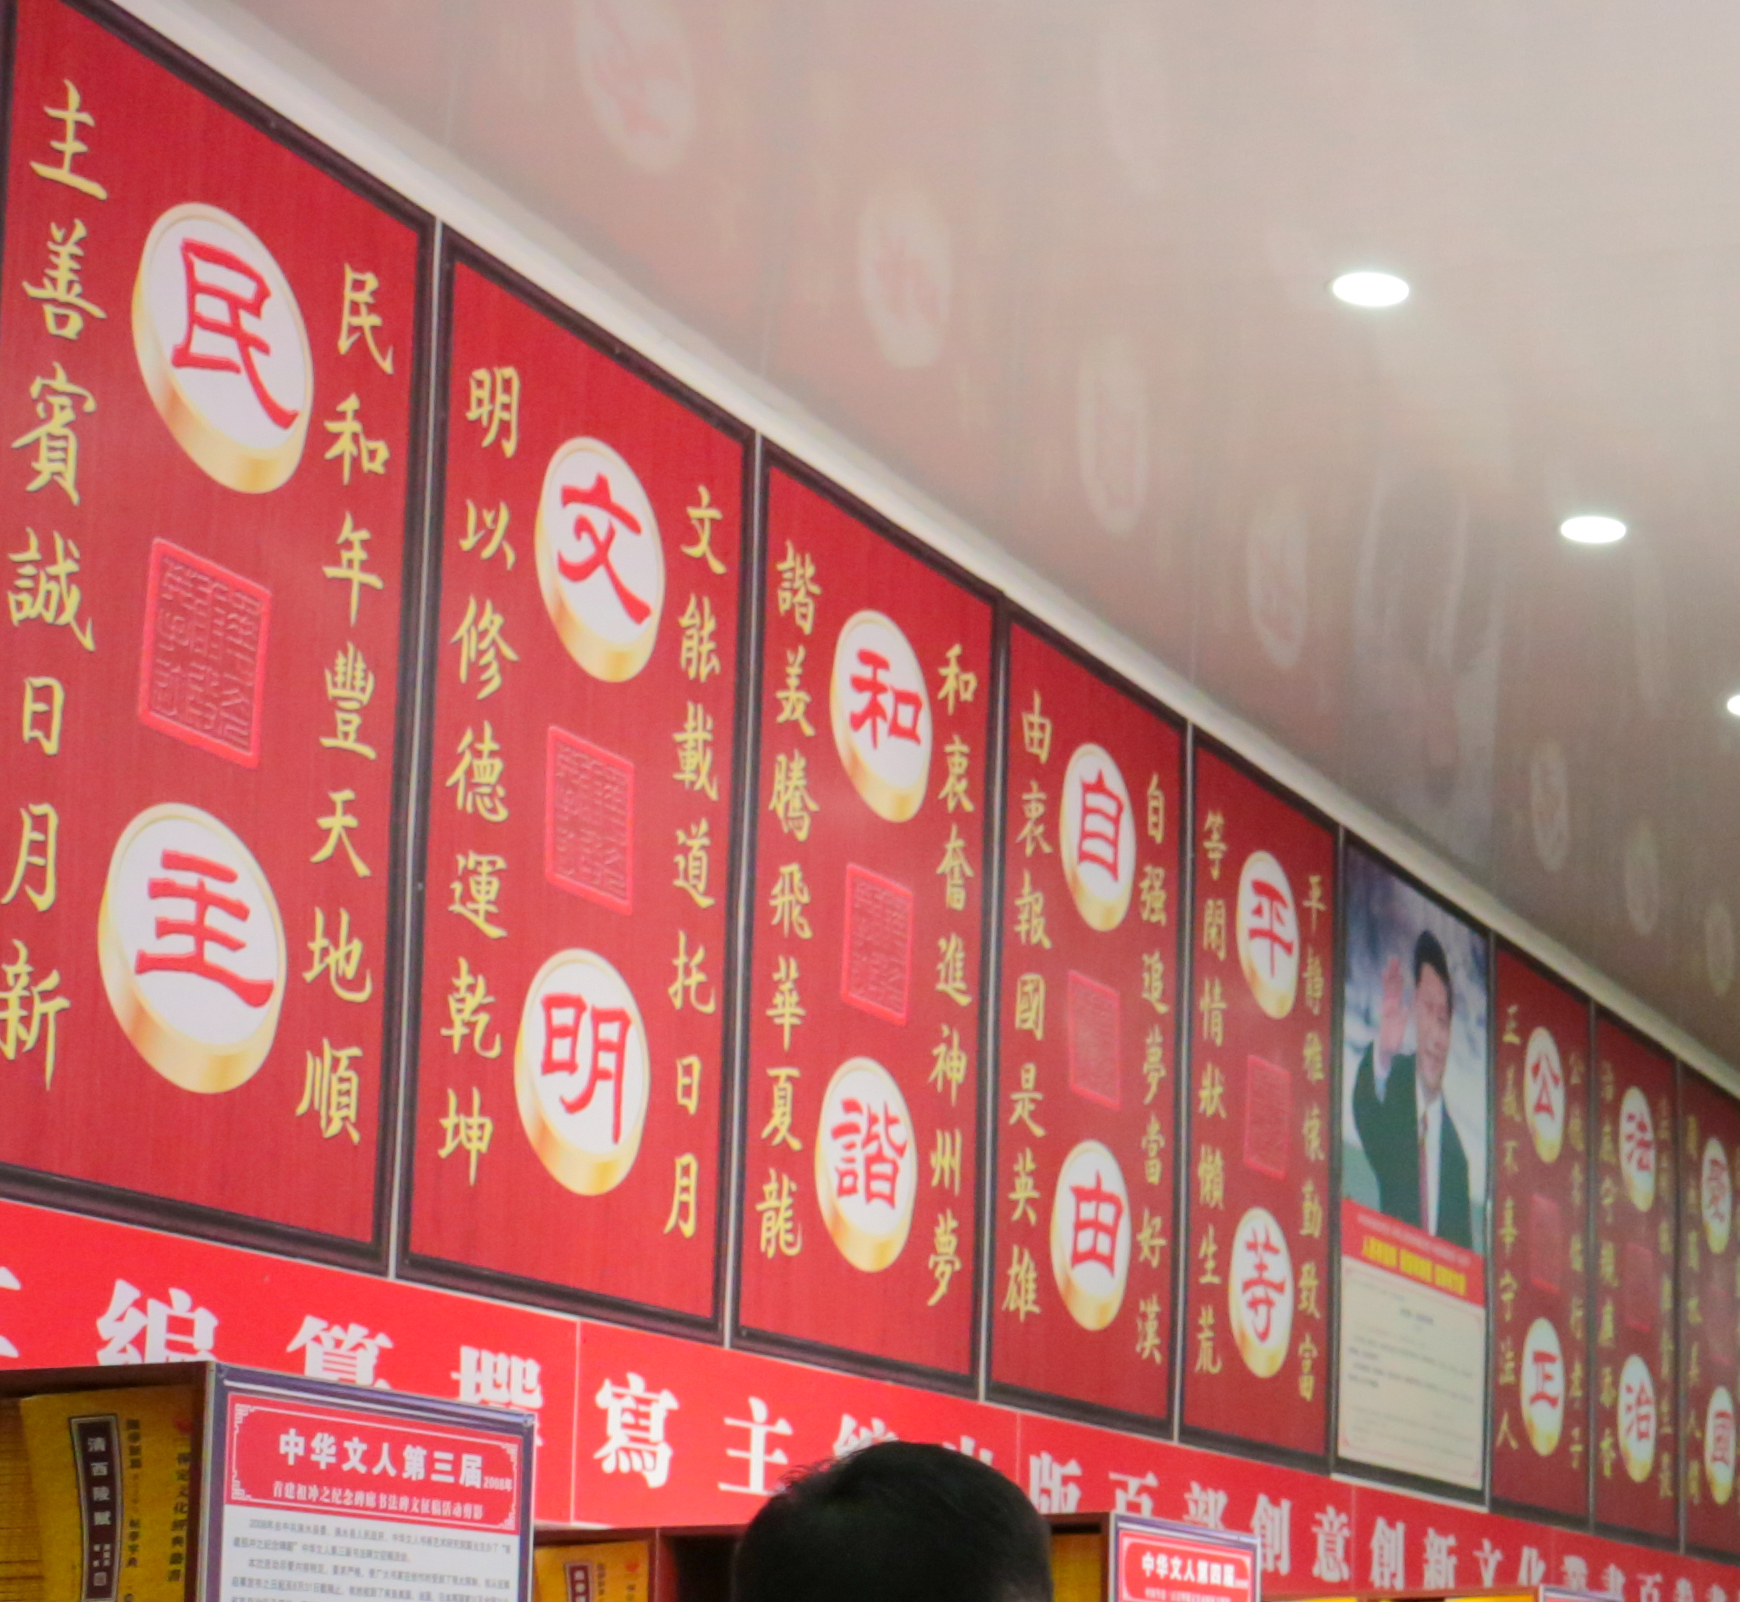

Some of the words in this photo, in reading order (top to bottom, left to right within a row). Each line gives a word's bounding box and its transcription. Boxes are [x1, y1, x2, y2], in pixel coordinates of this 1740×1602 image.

[171, 238, 299, 429] 民
[557, 473, 651, 626] 文
[296, 262, 393, 1144] 民和年豐天地順
[438, 366, 520, 1186] 明以修德運乾坤
[849, 649, 923, 750] 和
[663, 485, 726, 1238] 文能載道托日月
[755, 541, 822, 1258] 諧美騰飛華夏龍
[1076, 768, 1125, 883] 自
[134, 849, 275, 1009] 主
[926, 643, 978, 1307] 和衷奮進神州夢
[1248, 879, 1294, 978] 平
[540, 992, 632, 1145] 明
[1002, 690, 1053, 1324] 由衷報國是英雄
[831, 1097, 908, 1209] 諧
[1531, 1058, 1561, 1120] 公
[1069, 1171, 1124, 1279] 由
[1241, 1228, 1286, 1343] 等
[1529, 1349, 1560, 1408] 正
[279, 1427, 483, 1490] 中华文人第三届
